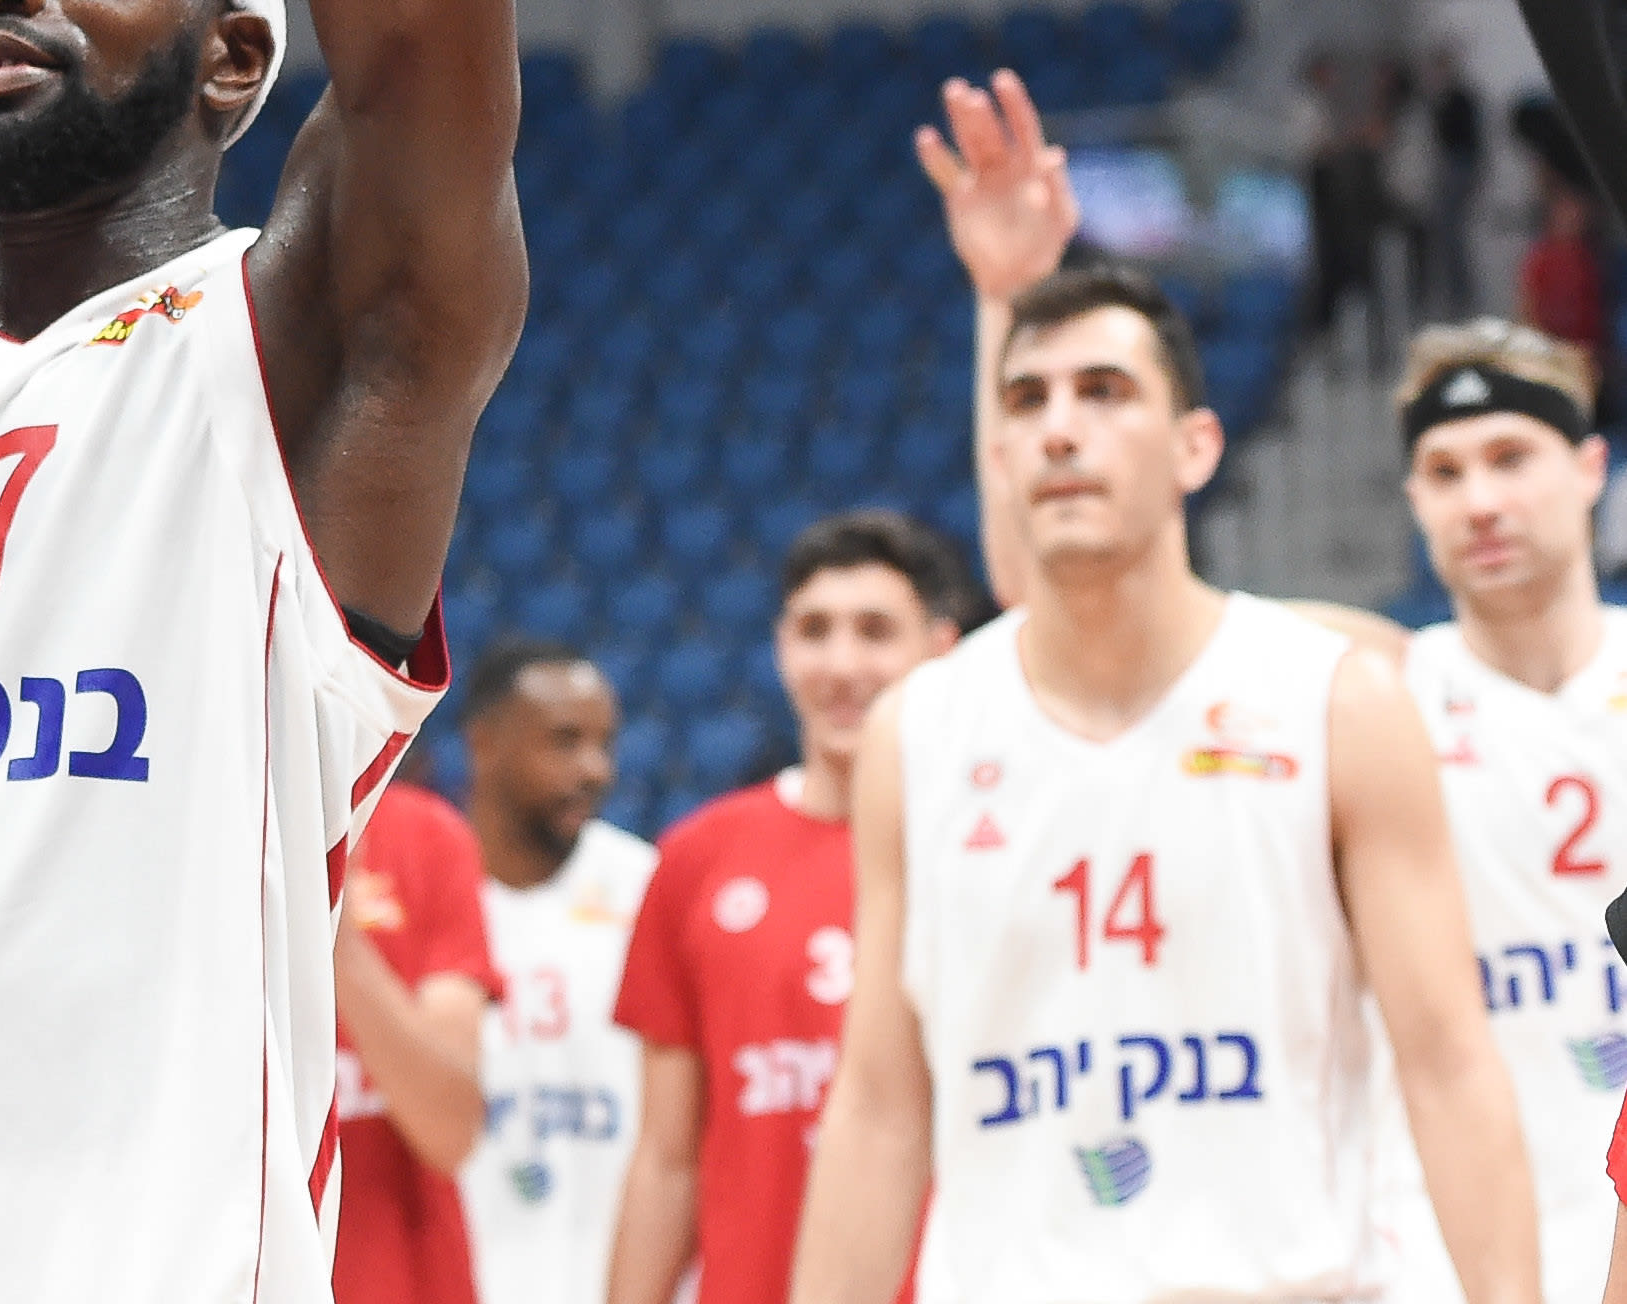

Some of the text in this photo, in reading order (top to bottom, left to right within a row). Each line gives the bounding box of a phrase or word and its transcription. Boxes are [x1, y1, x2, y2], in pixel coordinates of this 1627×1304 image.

[1543, 774, 1608, 877] 2
[1053, 852, 1167, 971] 14
[972, 1033, 1263, 1126] בנק יהב
